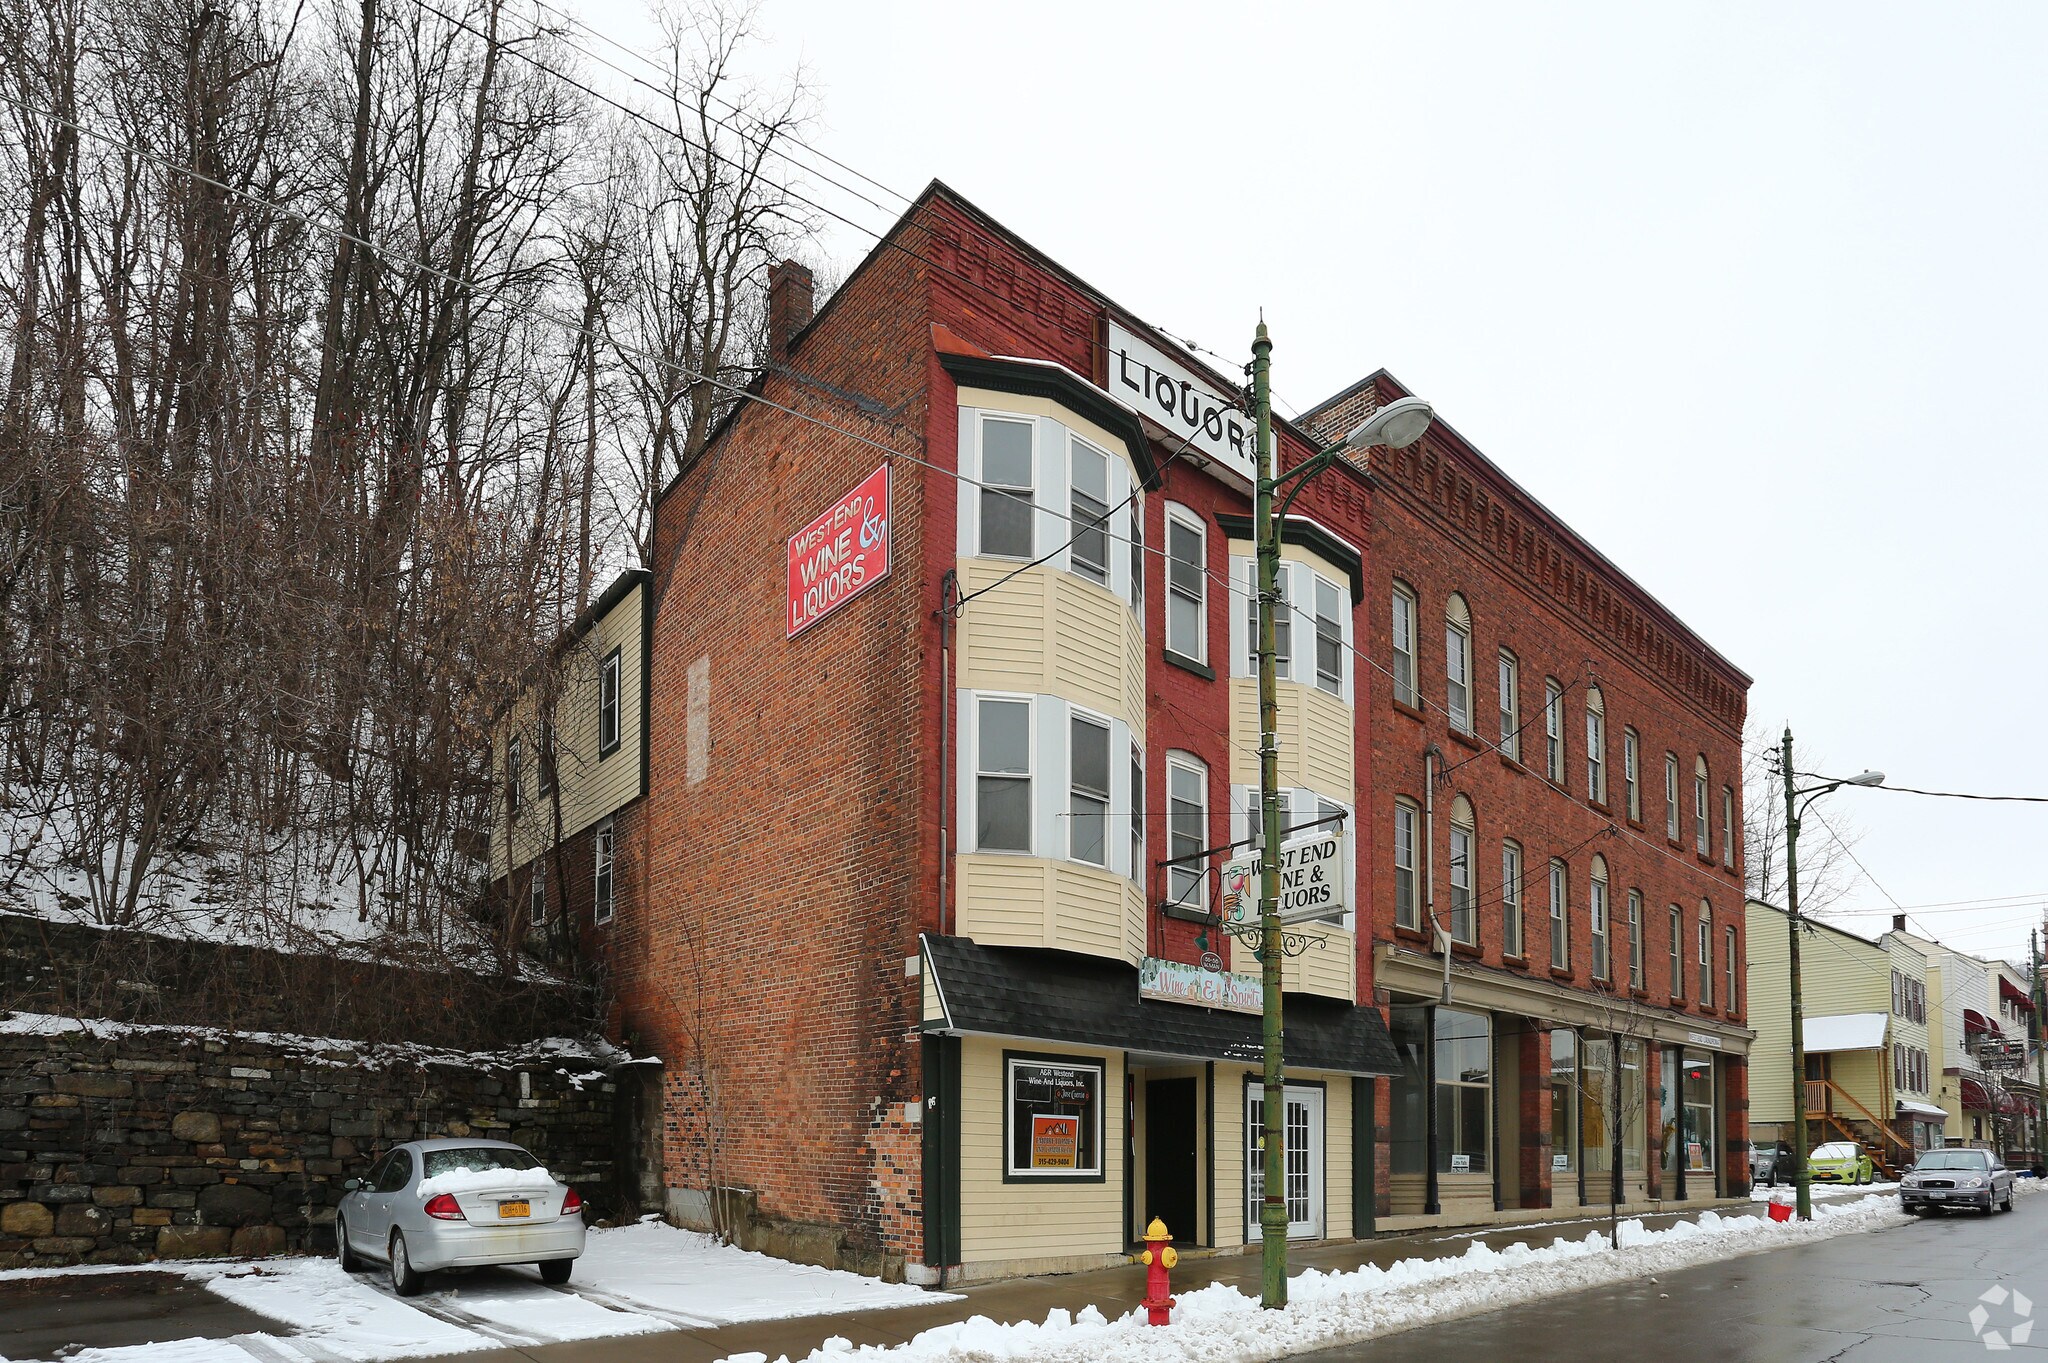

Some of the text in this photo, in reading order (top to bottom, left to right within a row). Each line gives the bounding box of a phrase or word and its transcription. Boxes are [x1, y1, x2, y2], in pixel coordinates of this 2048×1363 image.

[795, 496, 863, 558] WEST END
[801, 496, 886, 588] WINE &
[793, 554, 865, 628] LIQUORS
[1300, 840, 1336, 865] END
[1310, 865, 1324, 884] &
[1160, 971, 1260, 1008] Wine & Spirits
[1028, 1077, 1042, 1085] Wine
[1043, 1078, 1054, 1086] And
